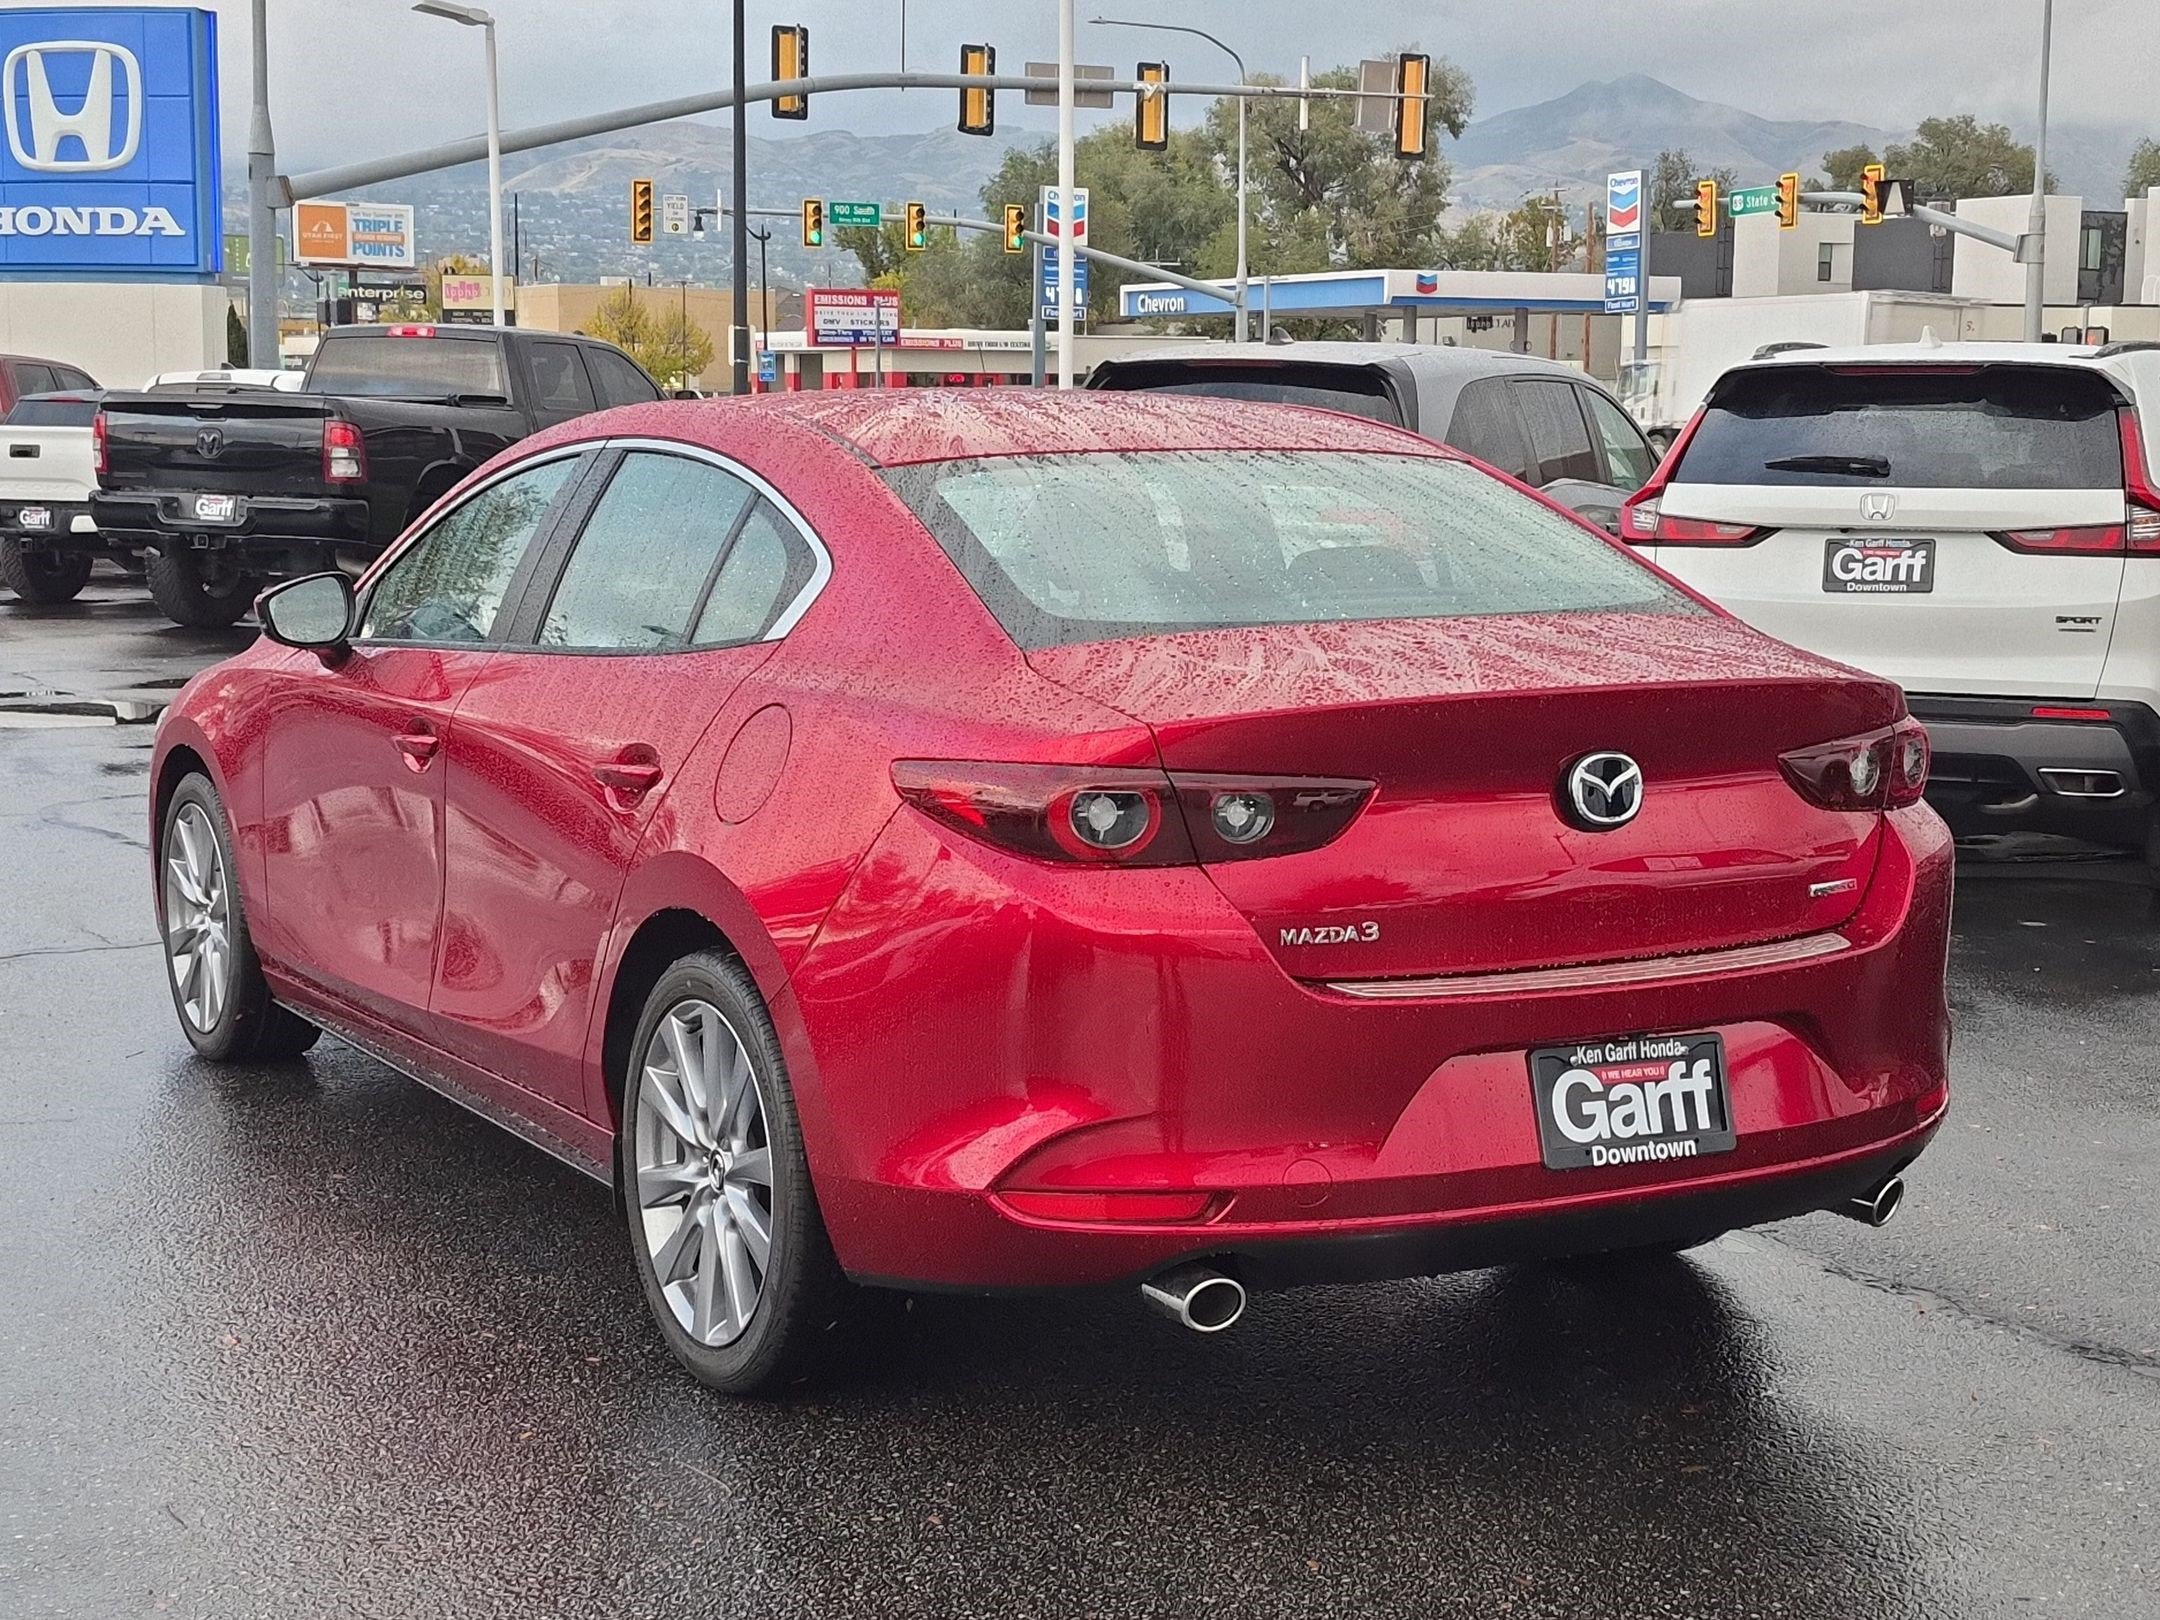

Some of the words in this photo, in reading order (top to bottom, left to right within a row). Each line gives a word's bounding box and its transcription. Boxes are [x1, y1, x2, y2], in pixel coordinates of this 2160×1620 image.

[1609, 177, 1638, 188] Chevron
[1047, 190, 1086, 201] Chon
[1746, 195, 1768, 209] State
[1770, 192, 1777, 205] S
[666, 202, 684, 210] YIELD
[834, 204, 850, 215] 900
[853, 205, 875, 216] South
[352, 217, 403, 234] TRIPLE
[352, 243, 405, 258] POINTS
[337, 285, 425, 302] enterprise
[814, 294, 867, 305] EMISSIONS
[1137, 294, 1185, 313] Chevron
[822, 318, 841, 326] DMV
[943, 339, 962, 348] PLUS
[195, 498, 234, 517] Garff
[20, 510, 51, 526] Garff
[1865, 539, 1884, 547] Garff
[1832, 547, 1927, 582] Garff
[1846, 582, 1907, 592] Downtown
[2055, 616, 2102, 624] SPORT
[1576, 1044, 1602, 1066] Ken
[1605, 1042, 1637, 1063] Garff
[1639, 1038, 1682, 1059] Honda
[1607, 1070, 1621, 1080] WE
[1621, 1068, 1643, 1079] HEAR
[1643, 1067, 1660, 1077] YOU
[1552, 1058, 1713, 1144] Garff
[1591, 1138, 1698, 1167] Downtown
